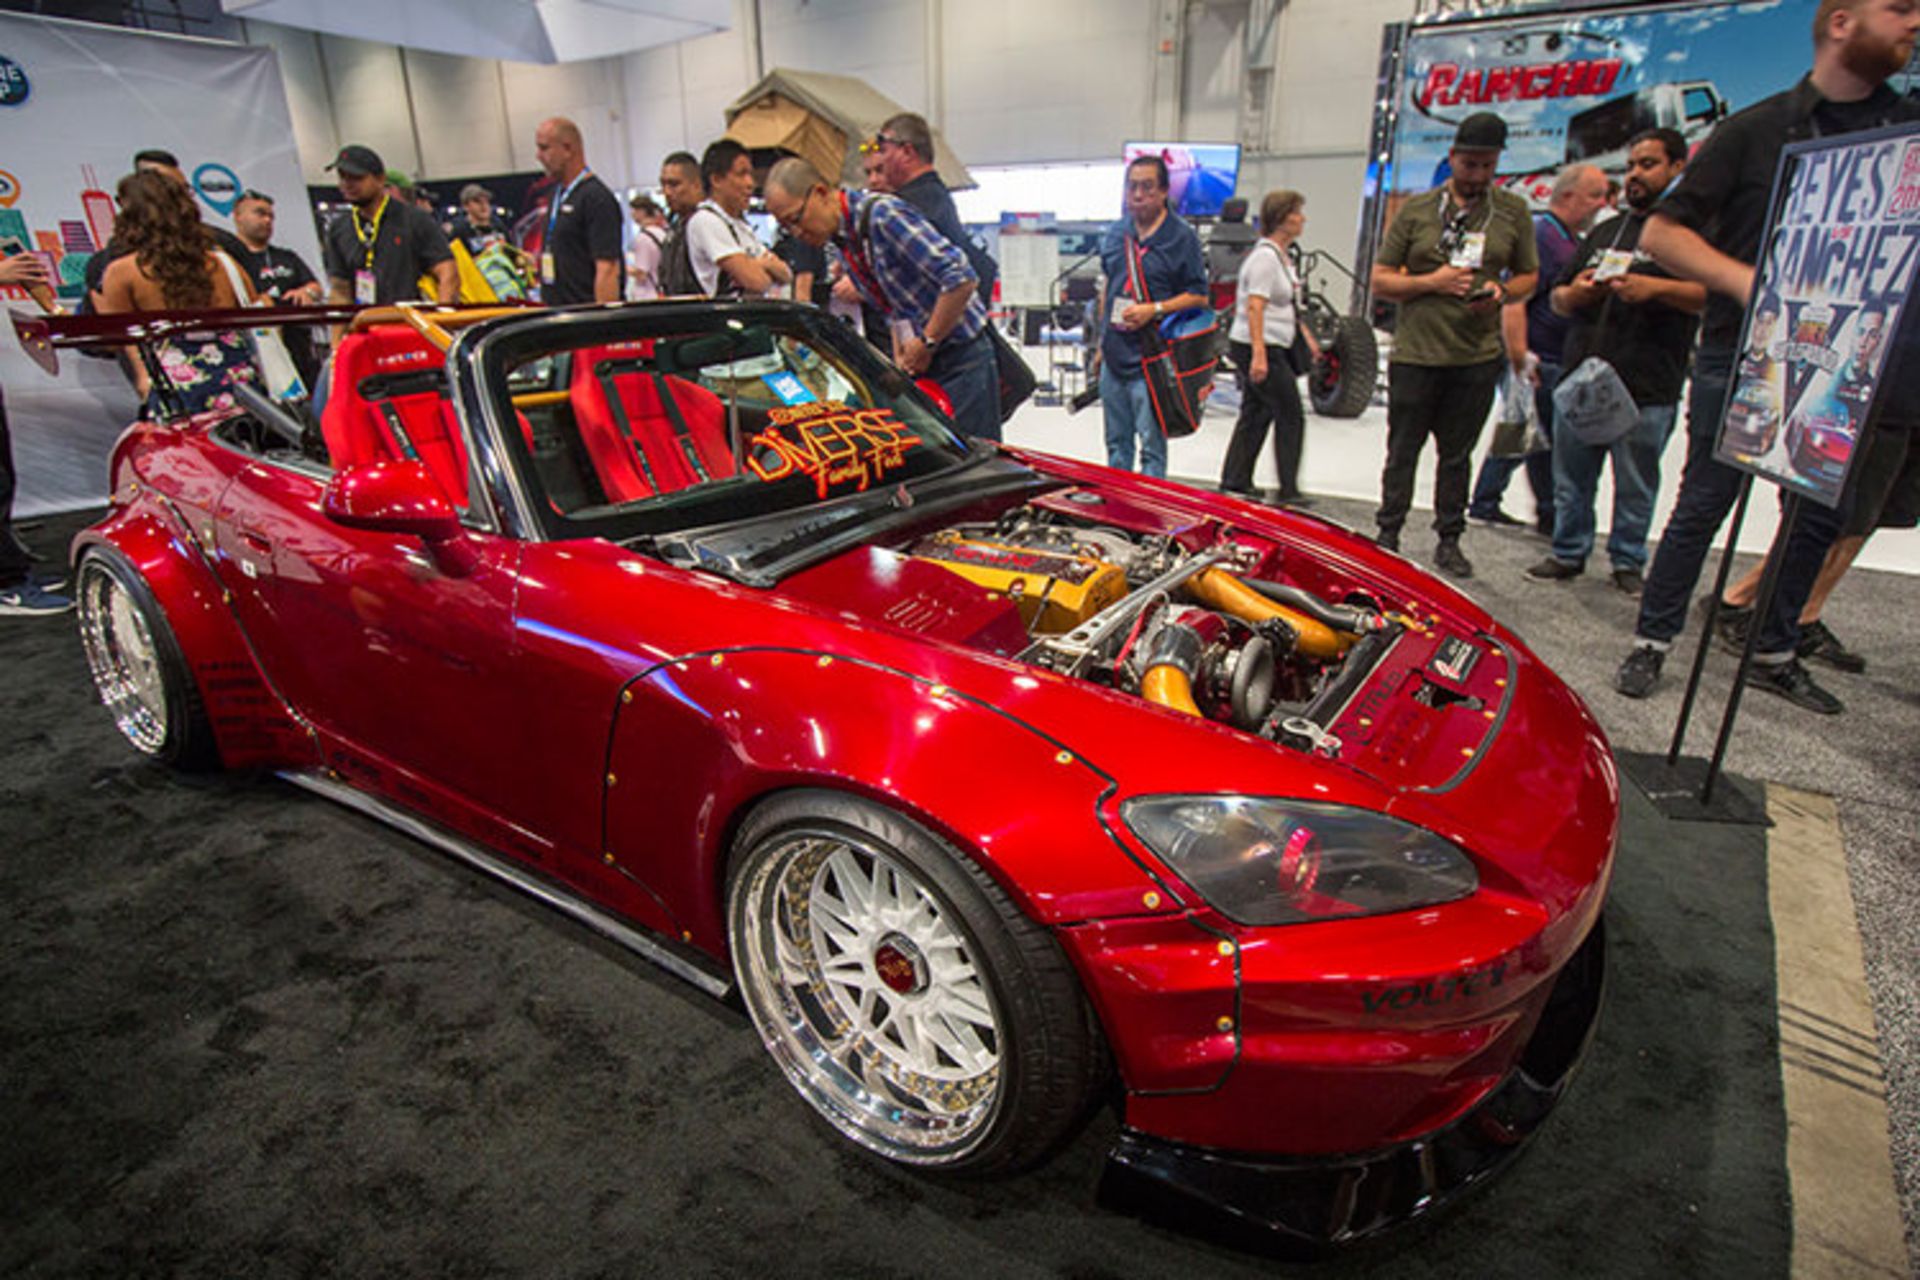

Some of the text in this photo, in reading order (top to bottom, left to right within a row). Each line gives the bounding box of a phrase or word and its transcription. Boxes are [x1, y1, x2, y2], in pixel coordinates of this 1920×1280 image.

[1420, 58, 1623, 107] RANCHO
[1786, 143, 1896, 225] REYES
[1762, 224, 1920, 303] SANCHEZ
